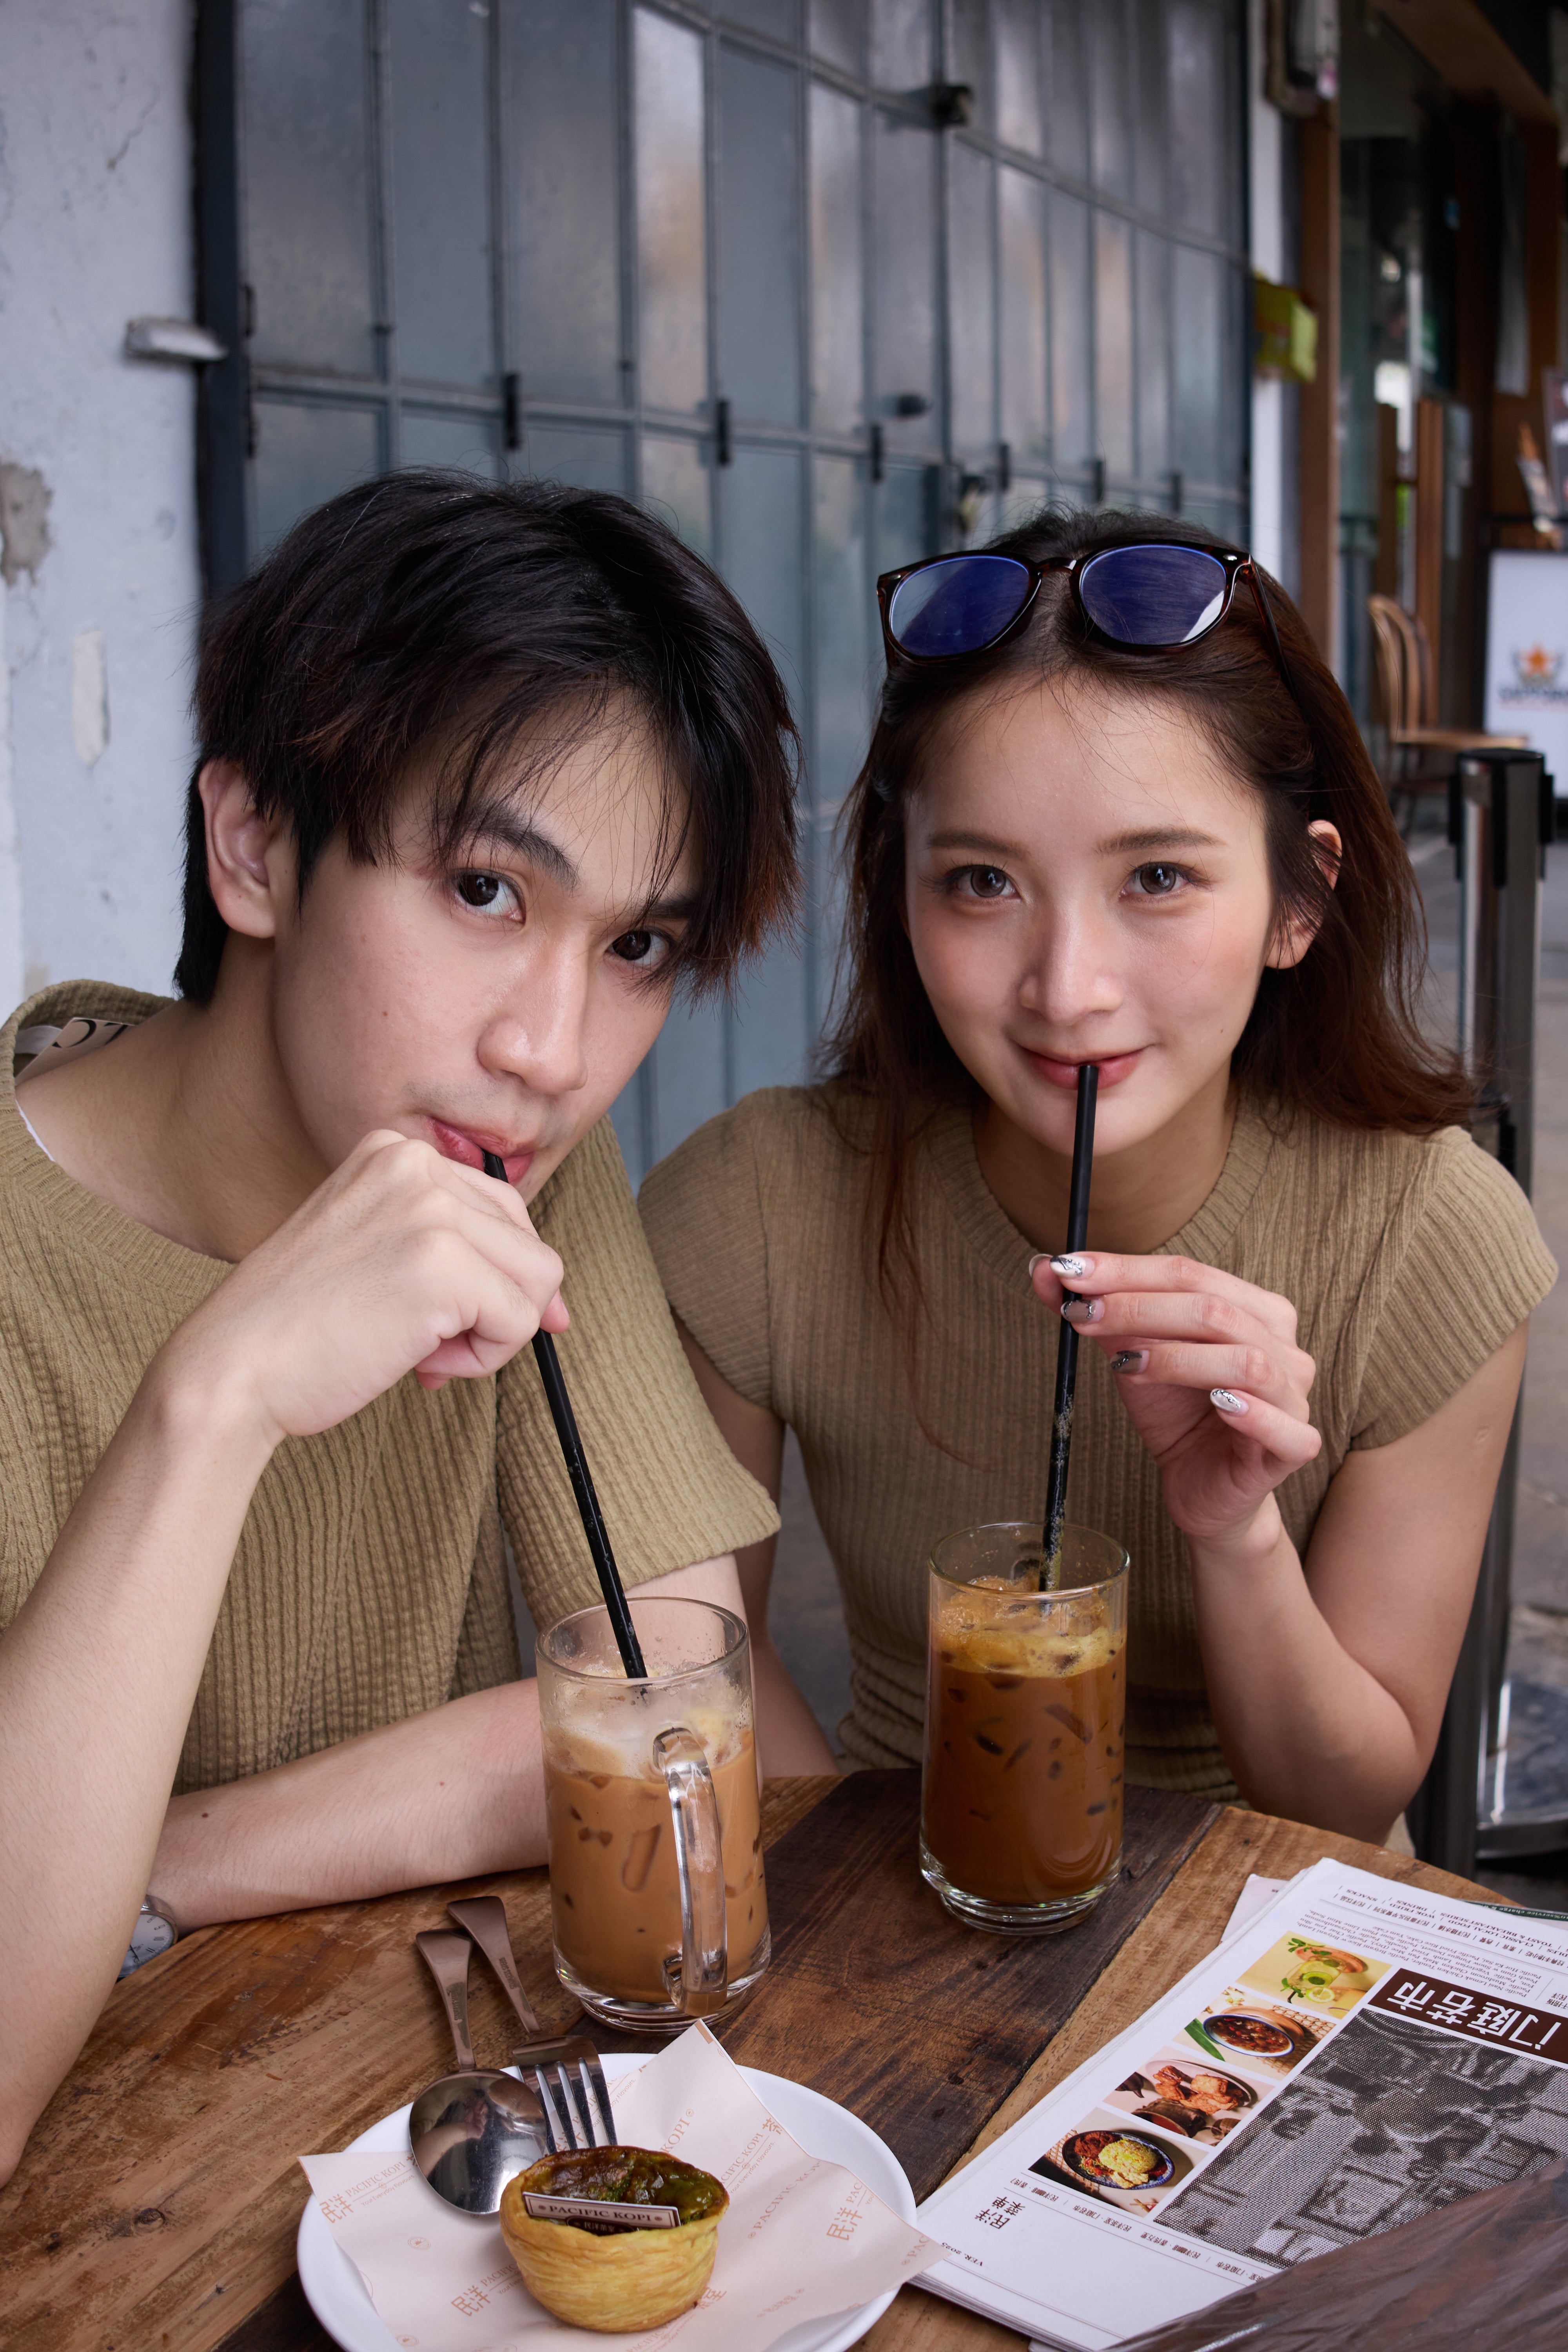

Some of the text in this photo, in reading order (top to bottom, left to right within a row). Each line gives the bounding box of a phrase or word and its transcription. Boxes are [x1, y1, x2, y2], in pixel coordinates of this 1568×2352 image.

[1347, 1889, 1377, 1901] SNACKS
[1340, 1896, 1366, 1907] 民洋饮品
[1397, 1900, 1427, 1911] DRINKS
[1390, 1904, 1414, 1912] FRIED
[1499, 1906, 1525, 1915] charge
[1310, 1910, 1326, 1918] Soda,
[1441, 1913, 1469, 1922] SERIES
[1297, 1922, 1316, 1931] Lamb,
[1305, 1914, 1356, 1934] Chrysanthemum
[1471, 1921, 1517, 1936] BREAKFAST
[1316, 1929, 1339, 1940] Briyani
[1359, 1933, 1380, 1941] Pacific
[1438, 1926, 1470, 1938] 民洋糖水铺
[1474, 1927, 1498, 1936] LOCAL
[1371, 1941, 1389, 1949] (Dry),
[1385, 1940, 1408, 1950] Noodle,
[1397, 1939, 1417, 1947] Pacific
[1503, 1936, 1533, 1947] CLASSIC
[1528, 1938, 1551, 1947] TOAST
[1363, 1945, 1387, 1954] Briyani
[1421, 1945, 1446, 1956] Dessert,
[1388, 1953, 1409, 1961] Pacific
[1448, 1954, 1471, 1963] Fungus
[1459, 1952, 1479, 1960] Pacific
[1526, 1951, 1564, 1966] 经典本地小吃
[1412, 1959, 1434, 1969] Tender,
[1442, 1963, 1468, 1973] Chicken
[1437, 1967, 1463, 1978] Chicken
[1465, 1976, 1487, 1985] Lemak
[1471, 1972, 1506, 1985] Mushroom
[1494, 1974, 1515, 1983] Pacific
[1505, 1989, 1526, 1997] Pacific
[1509, 1984, 1530, 1993] Pacific
[1387, 1982, 1561, 2050] 门庭若市
[617, 2079, 636, 2098] Flavours.
[661, 2118, 691, 2152] KOPI
[743, 2133, 764, 2158] KOPI
[729, 2141, 775, 2195] Your Everyday Flavours.
[346, 2173, 383, 2198] PACIFIC
[382, 2161, 406, 2180] KOPI
[361, 2174, 416, 2207] Your Everyday Flavours.
[320, 2194, 354, 2223] 民洋
[754, 2178, 797, 2230] PACIFIC
[992, 2197, 1025, 2216] 菜单
[550, 2205, 651, 2222] PACIFIC KOPI
[975, 2209, 1010, 2229] 民洋
[826, 2207, 863, 2241] 民洋
[941, 2241, 984, 2267] VER. 2025
[481, 2263, 518, 2287] PACIFIC
[498, 2285, 511, 2295] Your
[451, 2285, 491, 2316] 民洋
